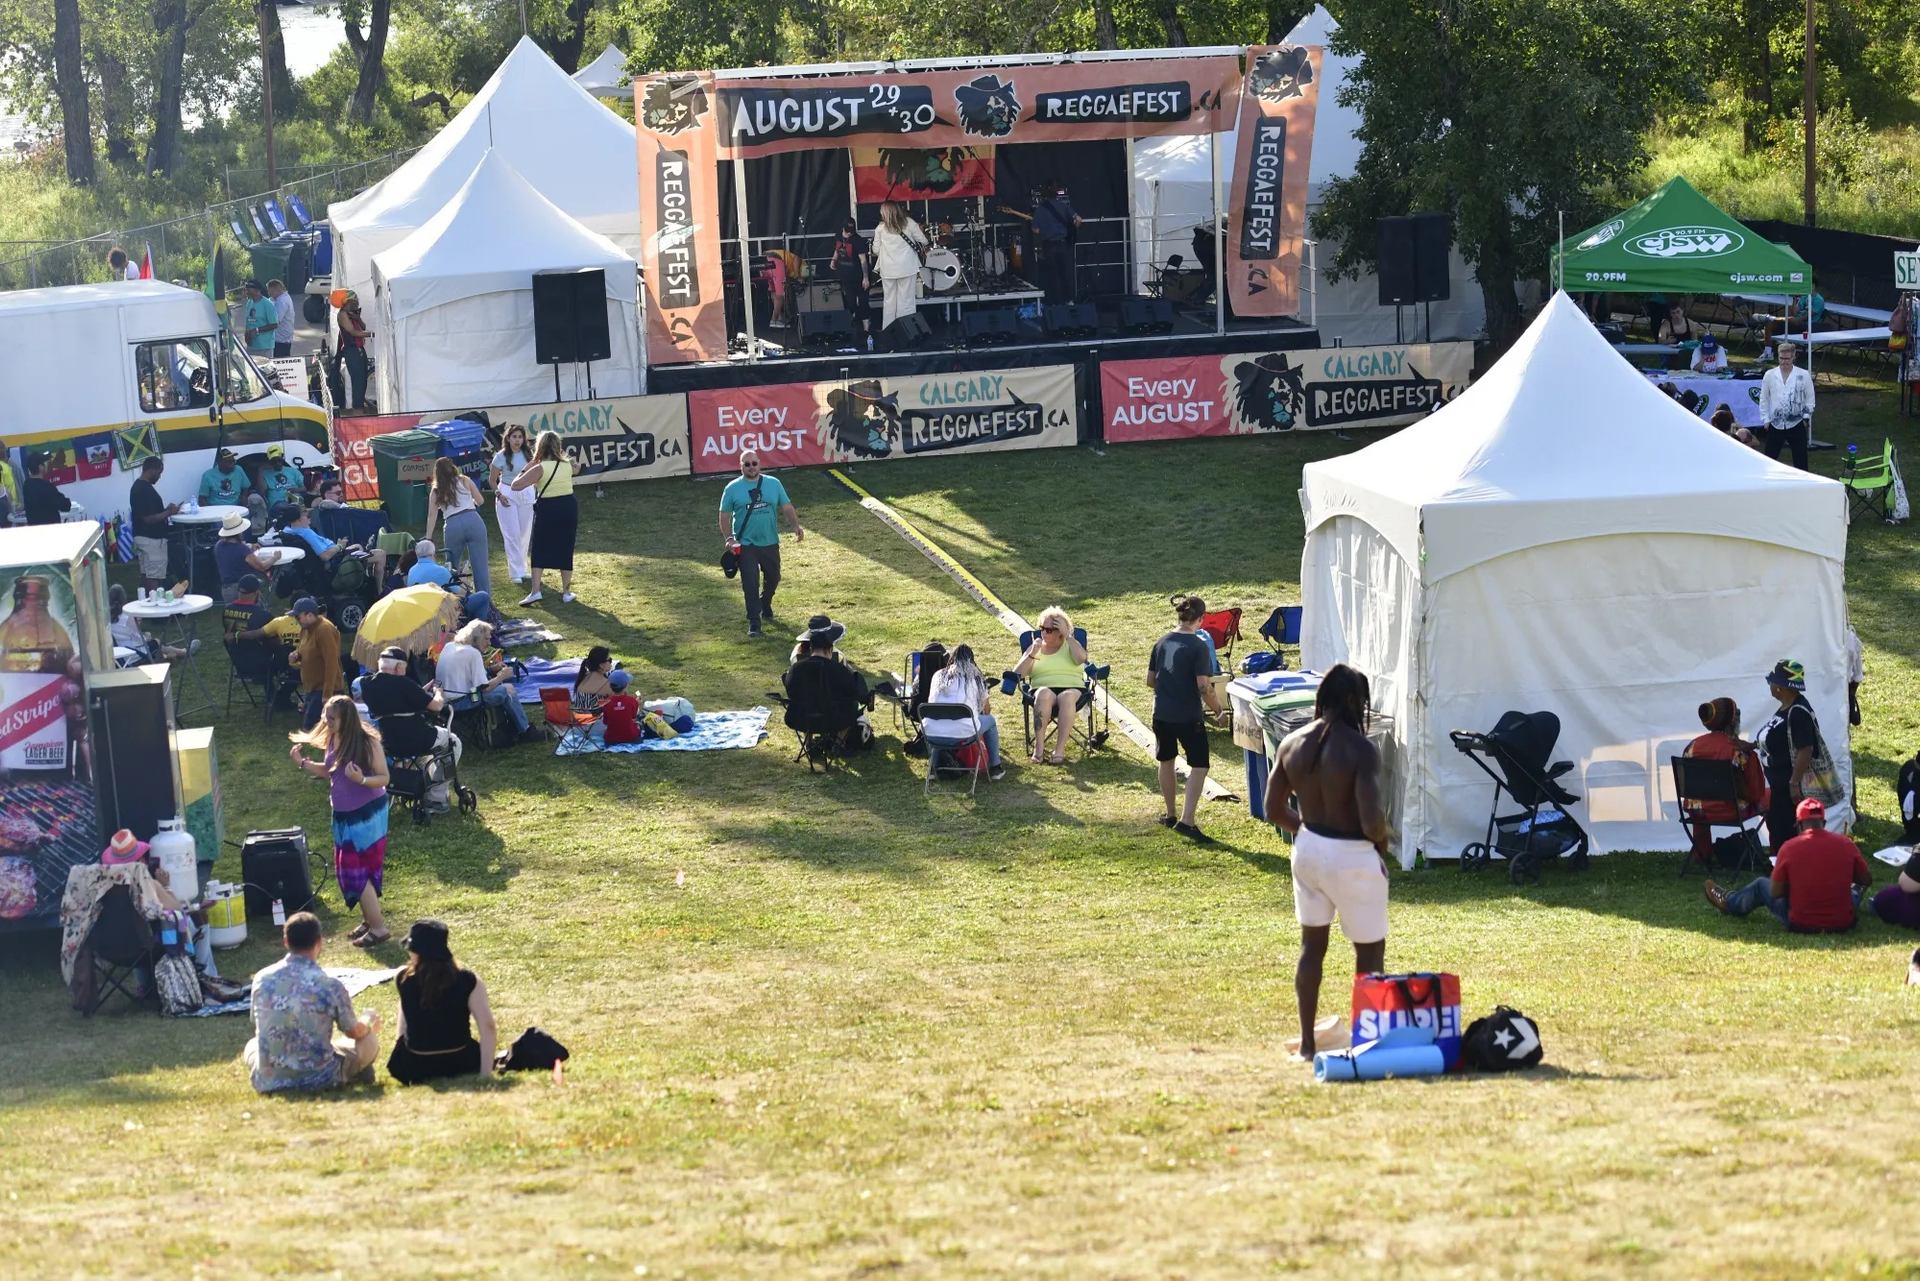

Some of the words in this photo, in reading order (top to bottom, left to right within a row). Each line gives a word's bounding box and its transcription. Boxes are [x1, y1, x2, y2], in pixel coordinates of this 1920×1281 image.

[732, 97, 865, 138] AUGUST
[869, 83, 901, 109] 29
[1046, 90, 1182, 118] REGGAEFEST
[1250, 126, 1281, 252] REGGAEFEST
[660, 161, 692, 299] REGGAEFEST
[1585, 272, 1627, 282] 90.9FM
[1730, 273, 1783, 283] cjsw.com
[1897, 256, 1920, 284] SE
[1324, 350, 1406, 379] CALGARY
[920, 376, 1004, 405] CALGARY
[1128, 376, 1197, 400] Every
[1315, 385, 1439, 419] REGGAEFEST
[528, 404, 614, 436] CALGARY
[718, 406, 788, 428] Every
[911, 409, 1038, 447] REGGAEFEST
[1112, 401, 1214, 426] AUGUST
[702, 429, 807, 457] AUGUST
